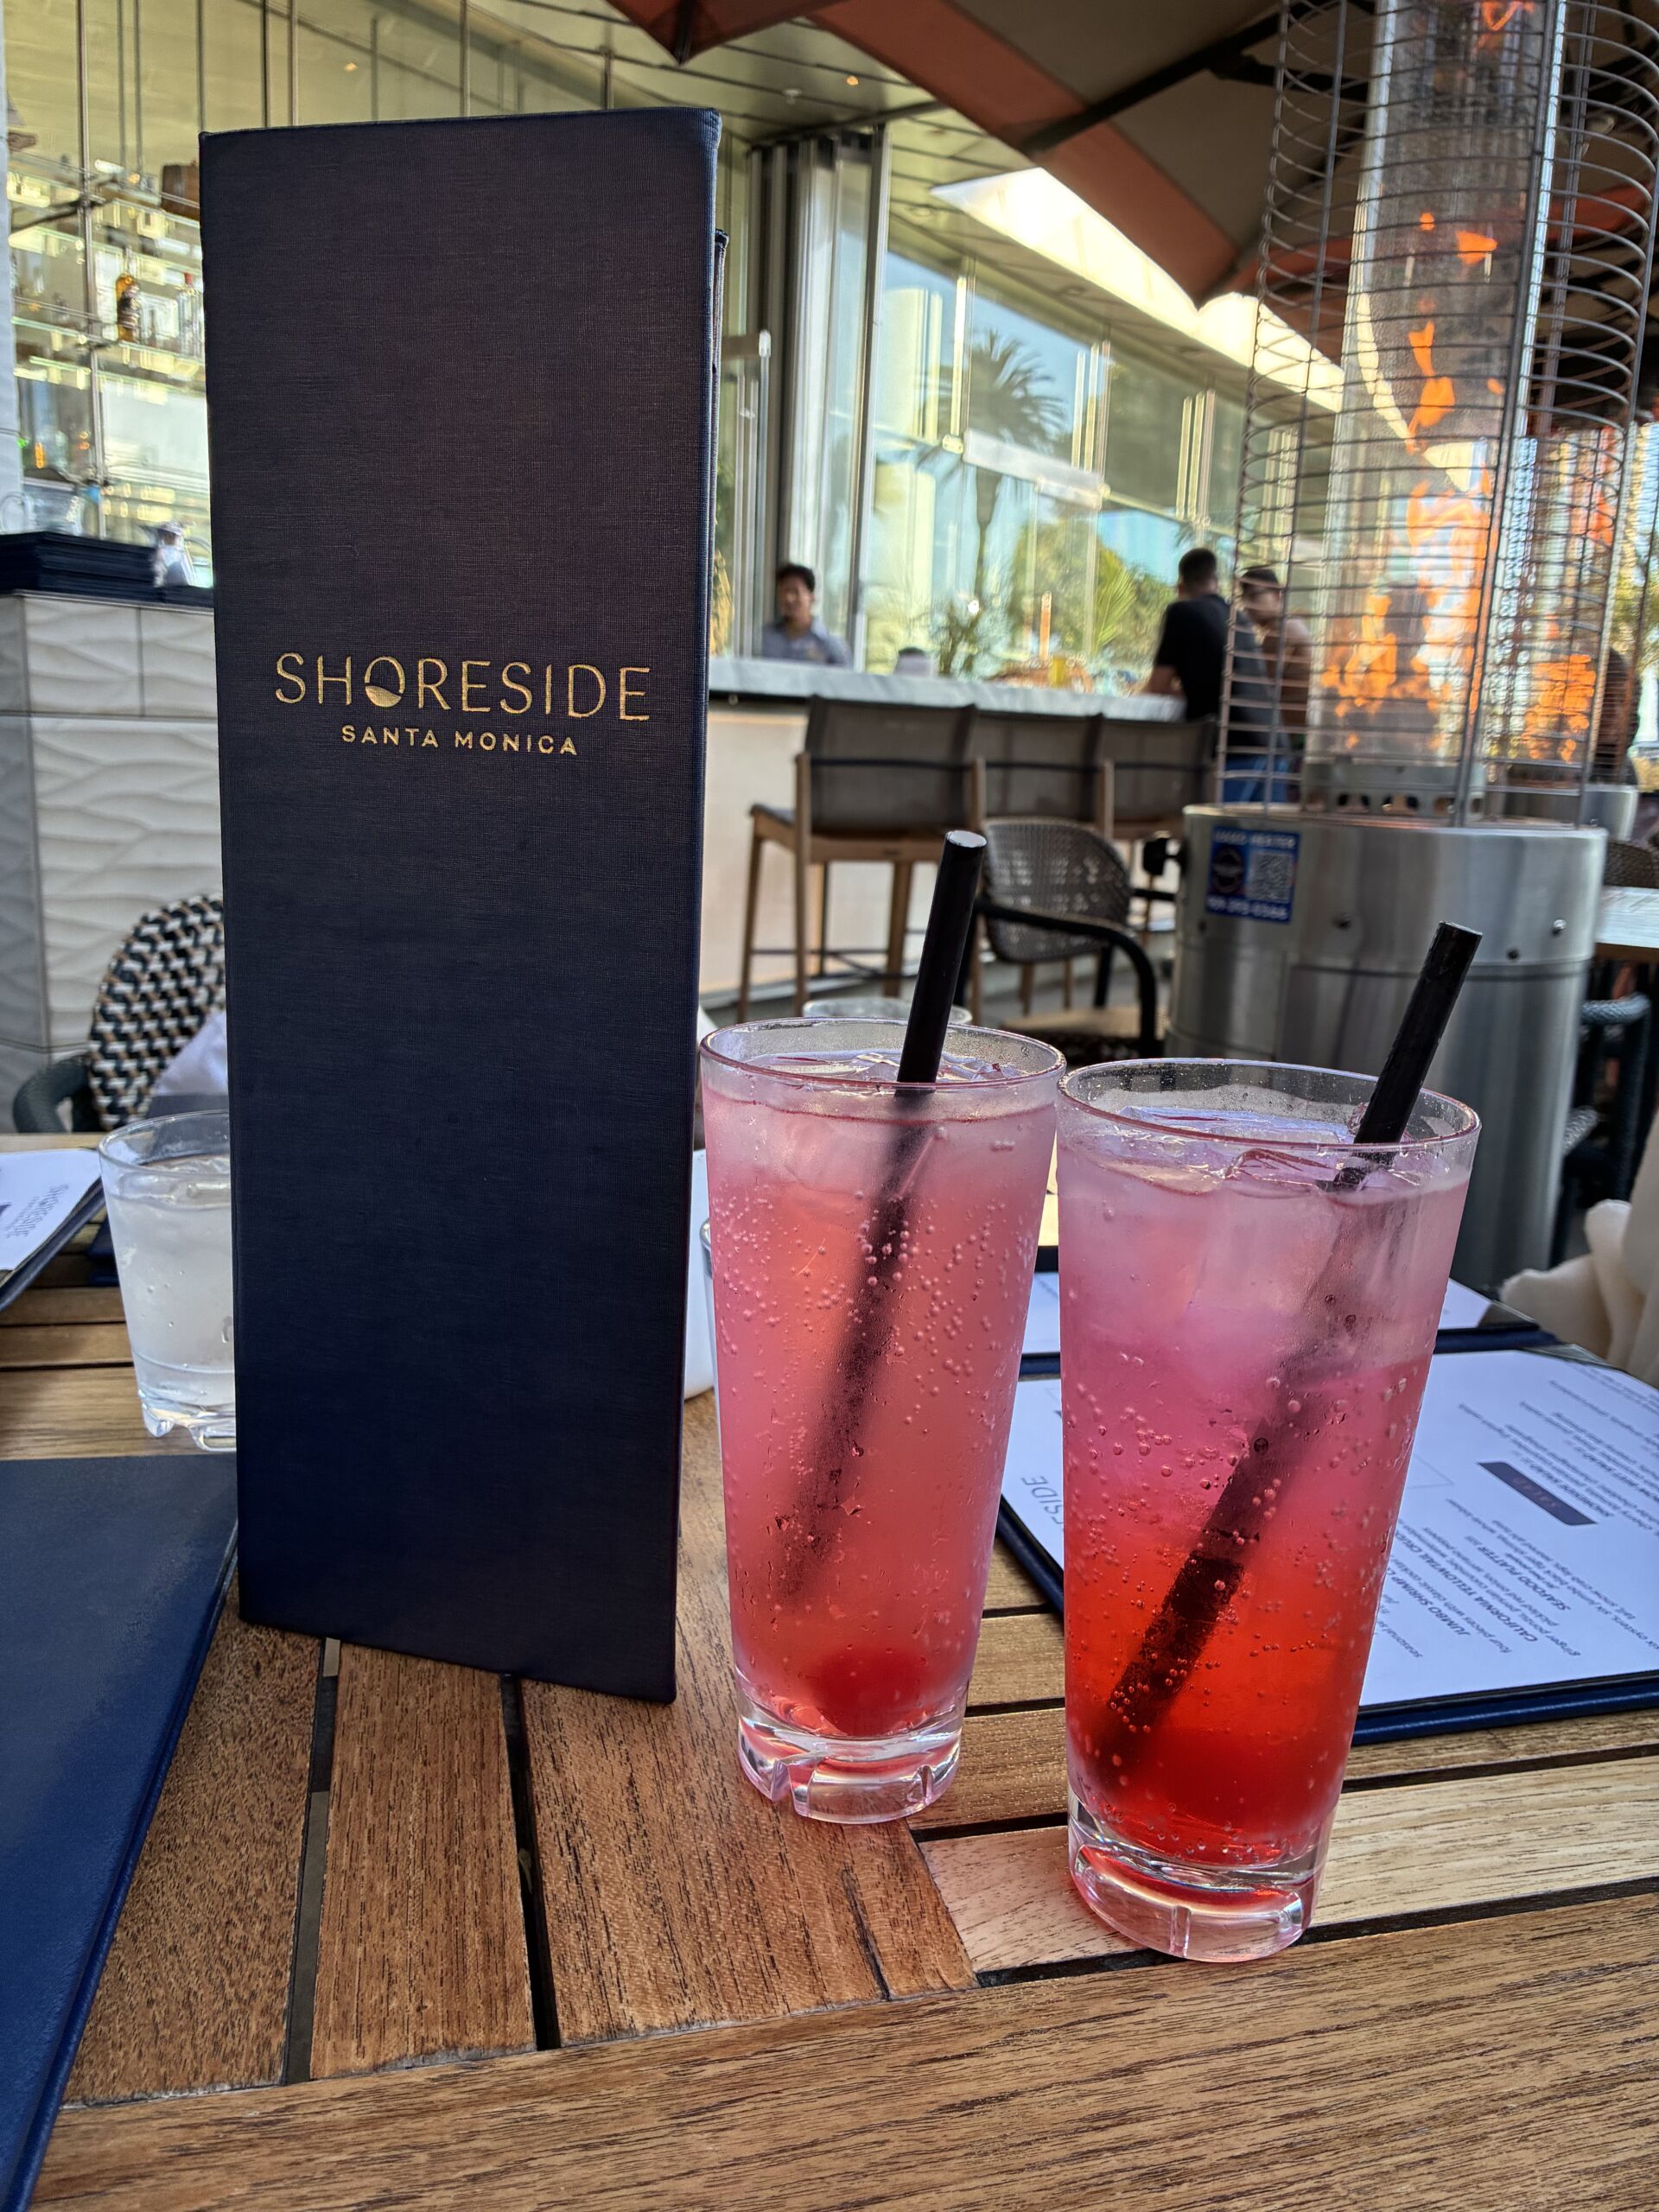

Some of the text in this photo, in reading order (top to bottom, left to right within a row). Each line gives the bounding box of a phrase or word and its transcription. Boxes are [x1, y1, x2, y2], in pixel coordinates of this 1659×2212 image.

[276, 652, 651, 721] SHORESIDE
[342, 724, 578, 755] SANTA MONICA
[1418, 1553, 1477, 1597] YELLOWTAIL
[1477, 1545, 1523, 1576] PLATTER
[1391, 1576, 1471, 1636] JUMBO SHRIMP
[1443, 1600, 1465, 1617] with
[1517, 1575, 1572, 1611] SEAFOOD
[1462, 1616, 1496, 1638] pieces
[1473, 1596, 1538, 1643] CALIFORNIA
[1382, 1629, 1423, 1657] seasonal
